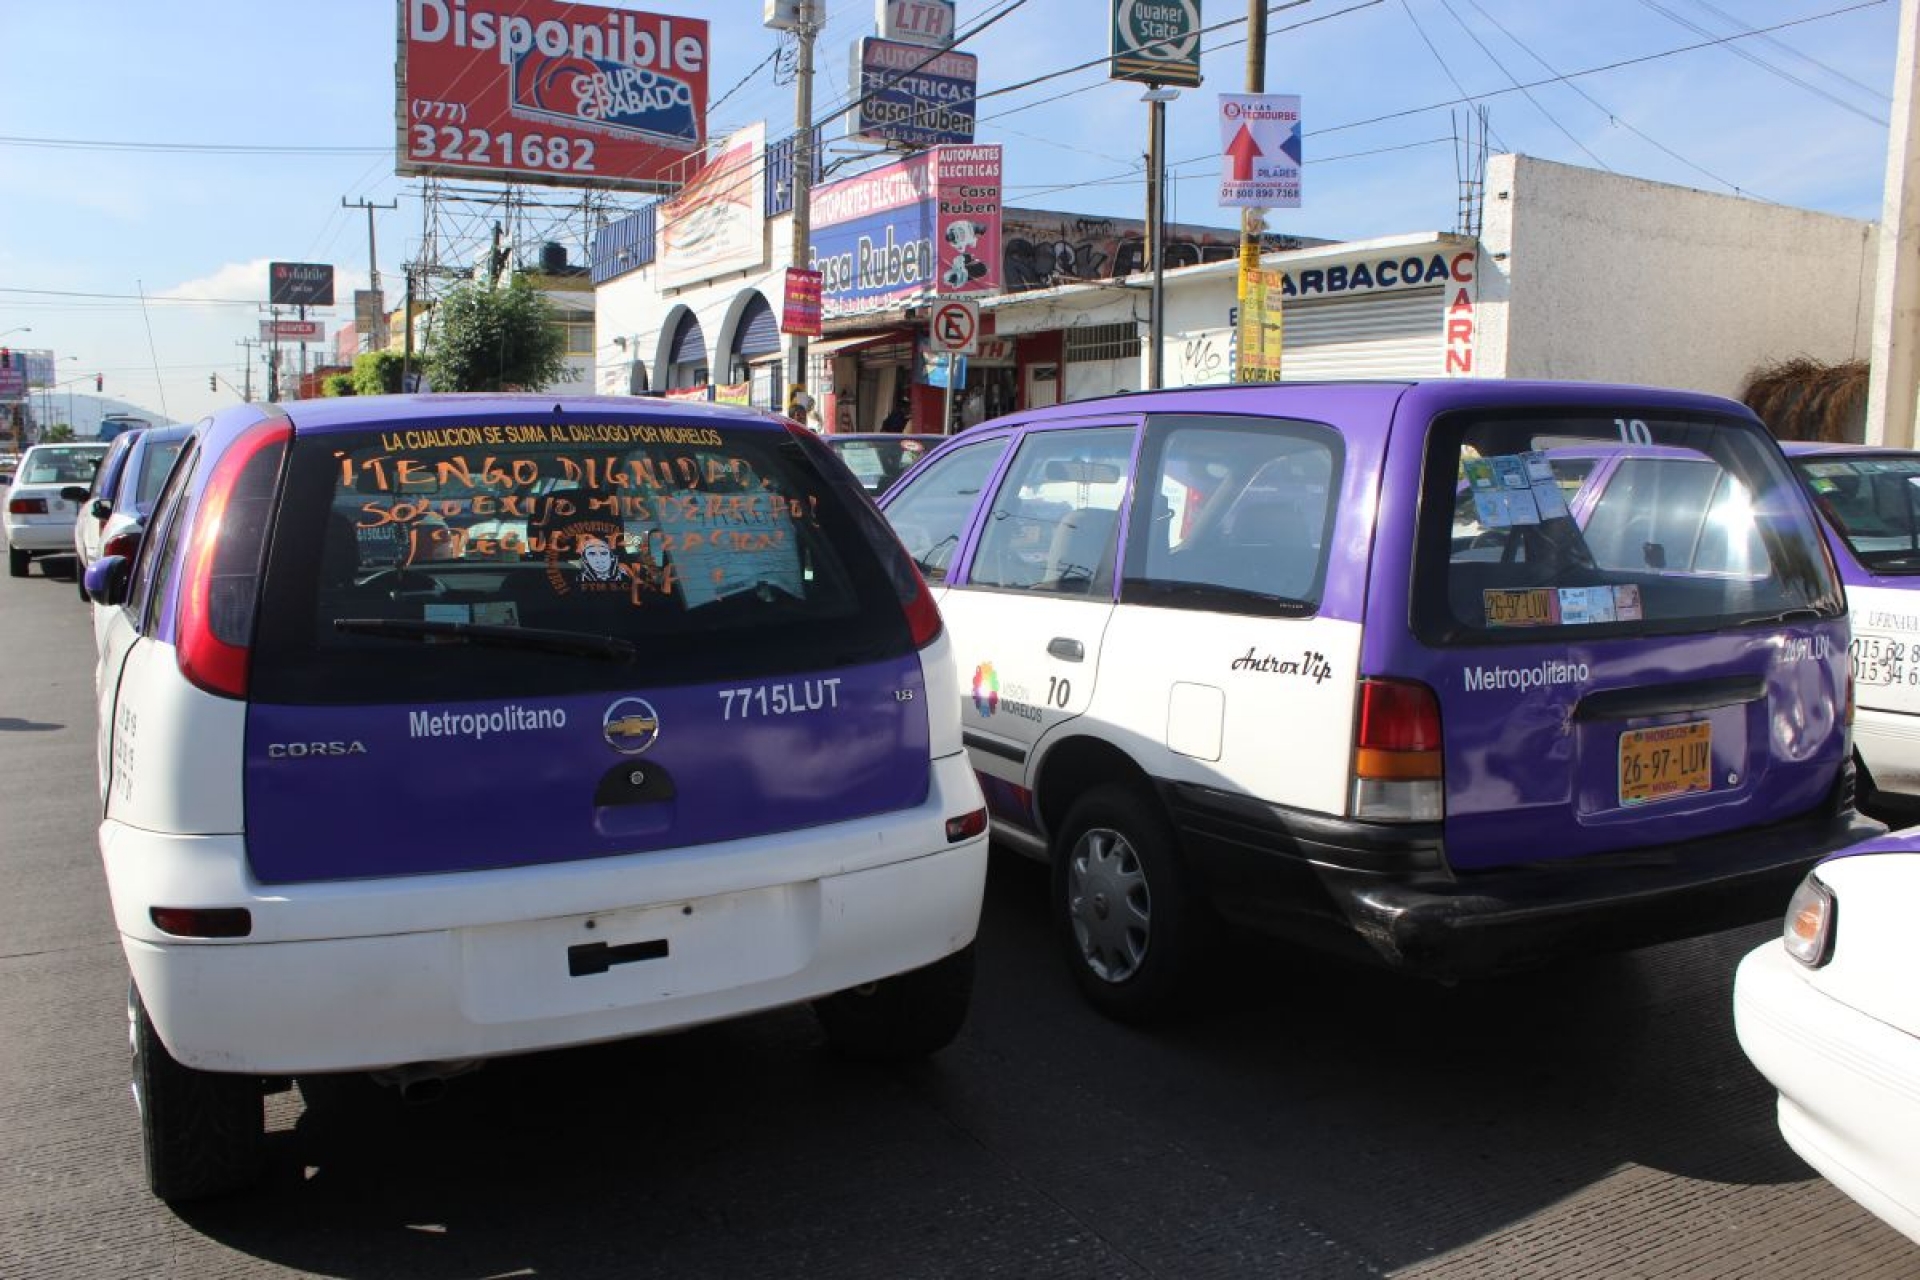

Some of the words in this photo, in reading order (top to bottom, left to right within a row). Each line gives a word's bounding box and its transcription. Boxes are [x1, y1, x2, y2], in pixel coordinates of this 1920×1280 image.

[895, 2, 945, 35] LTH
[1136, 1, 1183, 23] Quaker
[409, 0, 704, 72] Disponible
[1141, 20, 1179, 38] State
[873, 46, 974, 76] AUTOPARTES
[571, 68, 658, 98] GRUPO
[869, 72, 972, 100] ELECTRICAS
[412, 98, 467, 122] (777)
[577, 83, 692, 121] GRABADO
[861, 98, 911, 124] Casa
[411, 123, 596, 171] 3221682
[938, 148, 999, 162] AUTOPARTES
[938, 163, 999, 178] ELECTRICAS
[871, 164, 935, 208] ELECTRICAS
[958, 184, 997, 198] Casa
[940, 201, 997, 214] Ruben
[858, 225, 934, 291] Ruben
[382, 432, 404, 451] LA
[483, 426, 504, 444] SE
[506, 425, 548, 443] SUMA
[551, 426, 570, 441] AL
[570, 424, 630, 442] DIALOGO
[630, 426, 657, 442] POR
[658, 428, 722, 446] MORELOS
[1614, 418, 1652, 447] 10
[1464, 660, 1590, 692] Metropolitano
[719, 677, 841, 720] 7715LUT
[1047, 675, 1072, 708] 10
[408, 705, 567, 739] Metropolitano
[1000, 698, 1043, 723] MORELOS
[268, 740, 367, 759] CORSA
[1623, 741, 1710, 786] 26-97-LUV
